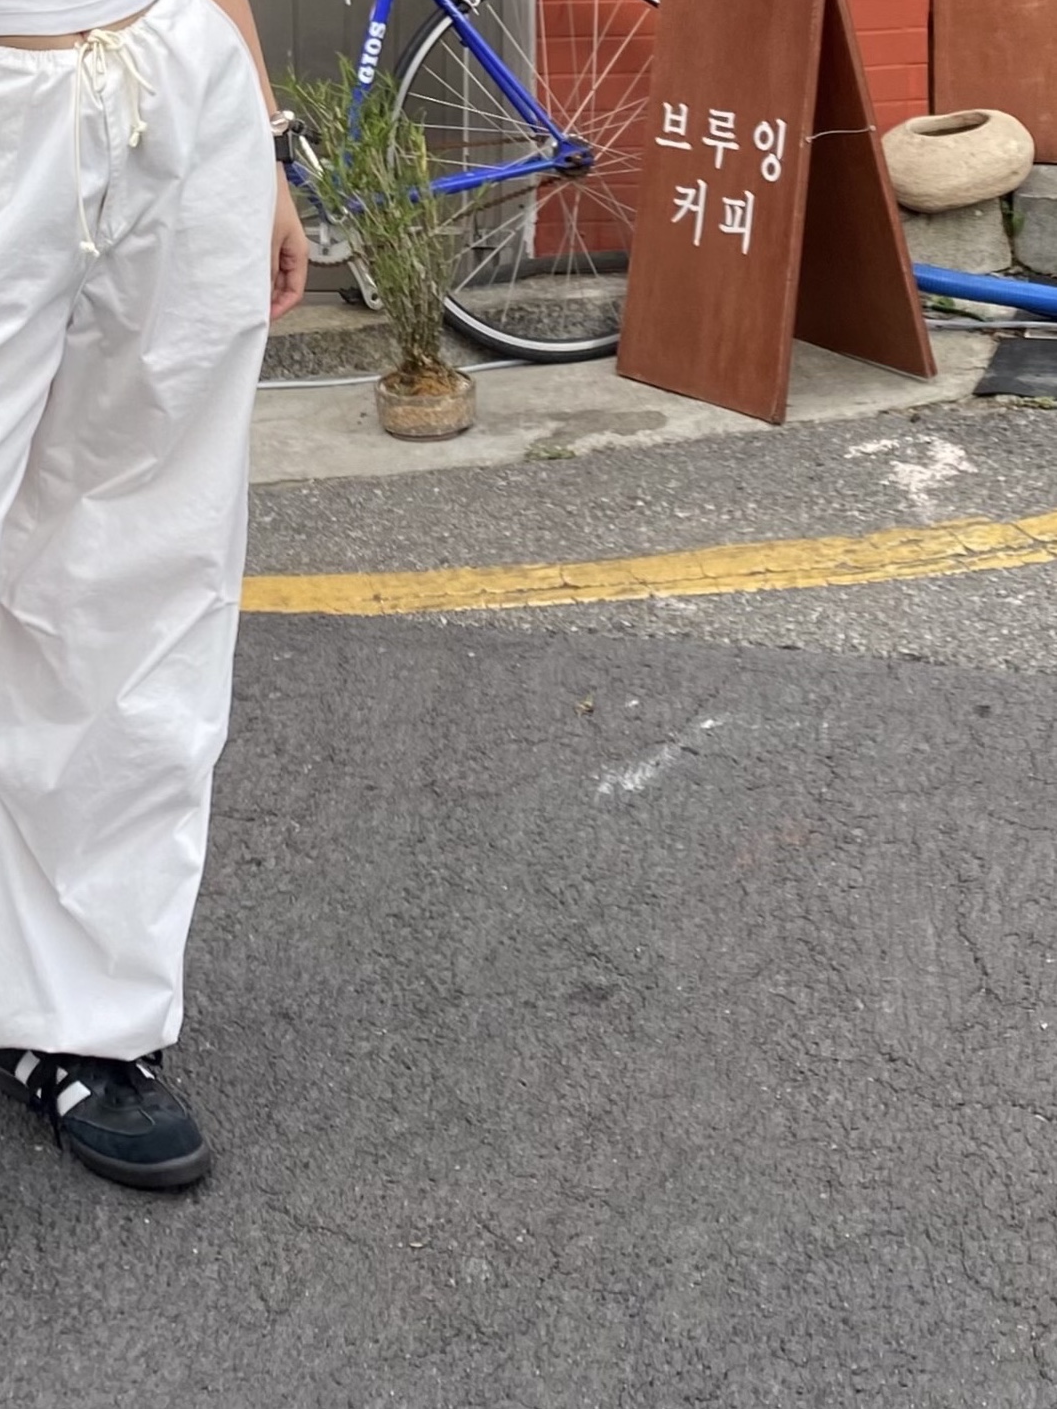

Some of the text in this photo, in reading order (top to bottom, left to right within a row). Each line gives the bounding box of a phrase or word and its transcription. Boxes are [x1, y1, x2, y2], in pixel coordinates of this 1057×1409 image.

[357, 21, 387, 85] GIOS
[655, 101, 788, 182] 브루잉
[670, 178, 756, 256] 커피
